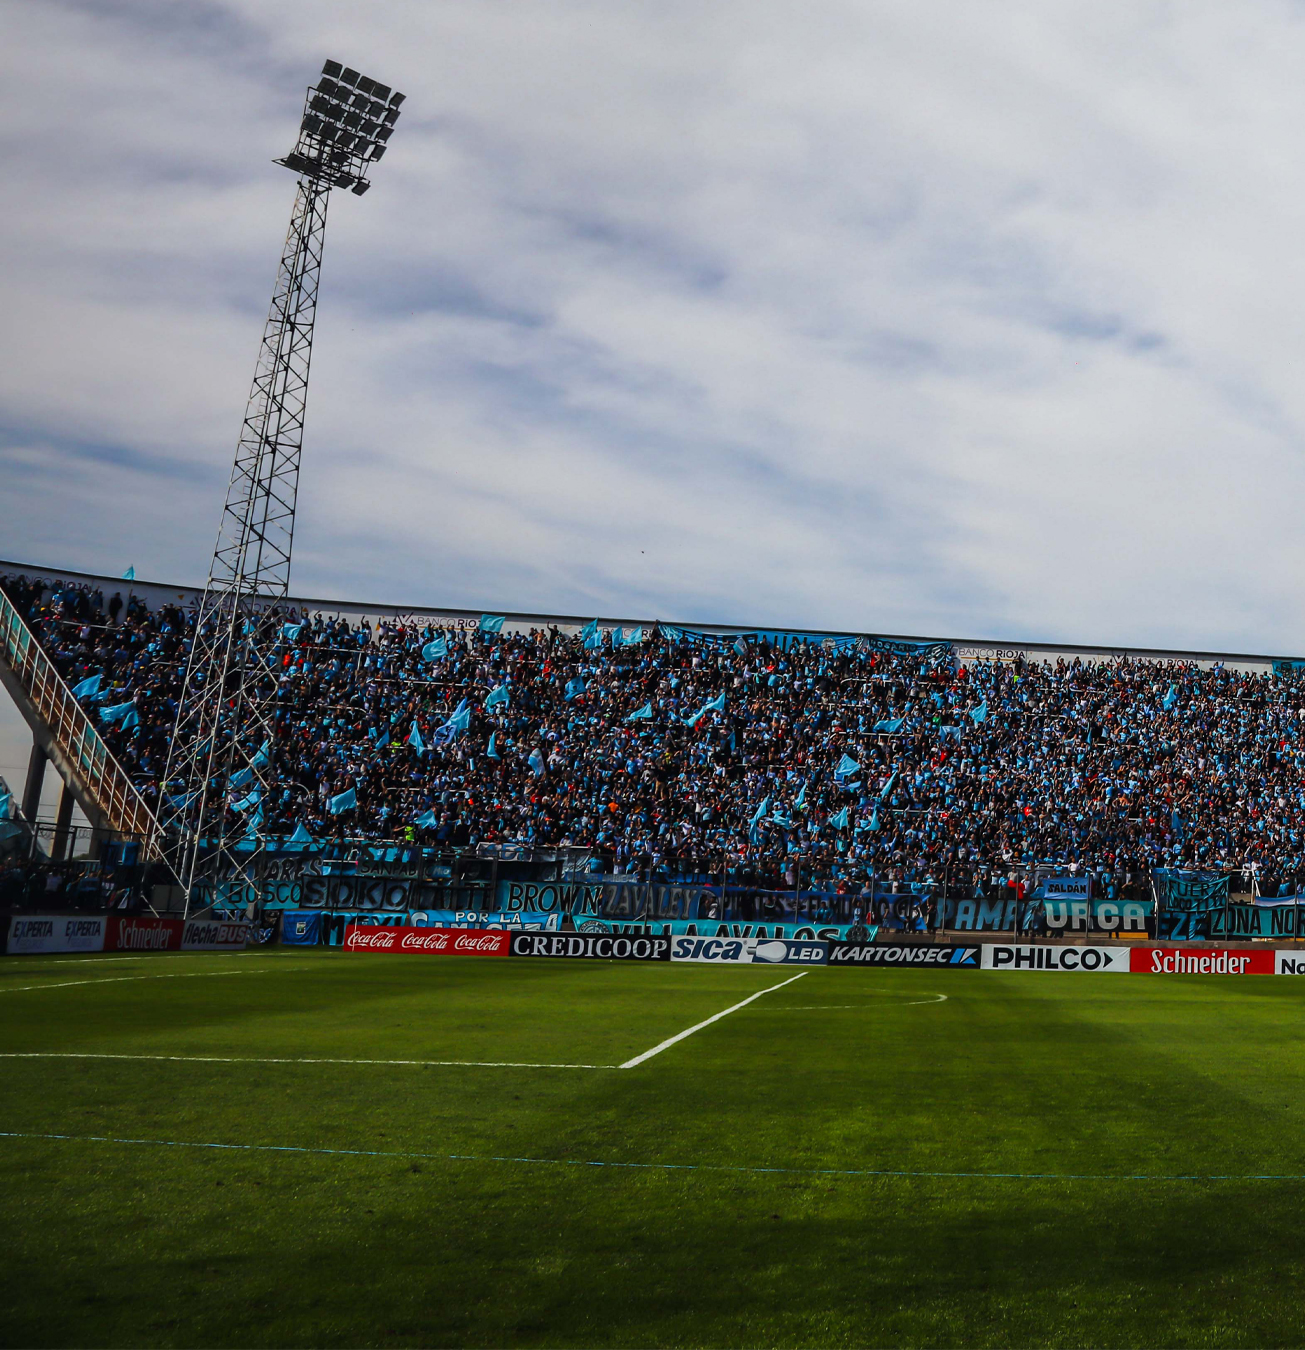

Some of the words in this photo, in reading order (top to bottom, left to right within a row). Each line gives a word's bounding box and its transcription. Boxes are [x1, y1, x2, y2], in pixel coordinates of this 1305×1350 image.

[958, 648, 994, 658] BANCO
[305, 880, 409, 908] SOKO
[507, 883, 603, 915] BROWN
[1048, 881, 1087, 895] SALDÁN
[455, 911, 488, 923] POR
[499, 913, 521, 924] LA
[1046, 902, 1146, 931] URCA
[1212, 908, 1262, 936] ZONA
[13, 921, 53, 940] EXPERTA
[65, 921, 101, 939] EXPERTA
[117, 918, 172, 949] Schneider
[513, 935, 668, 959] CREDICOOP
[788, 947, 824, 961] LED
[829, 946, 953, 963] KARTONSEC
[992, 947, 1102, 970] PHILCO
[1151, 949, 1251, 975] Schneider
